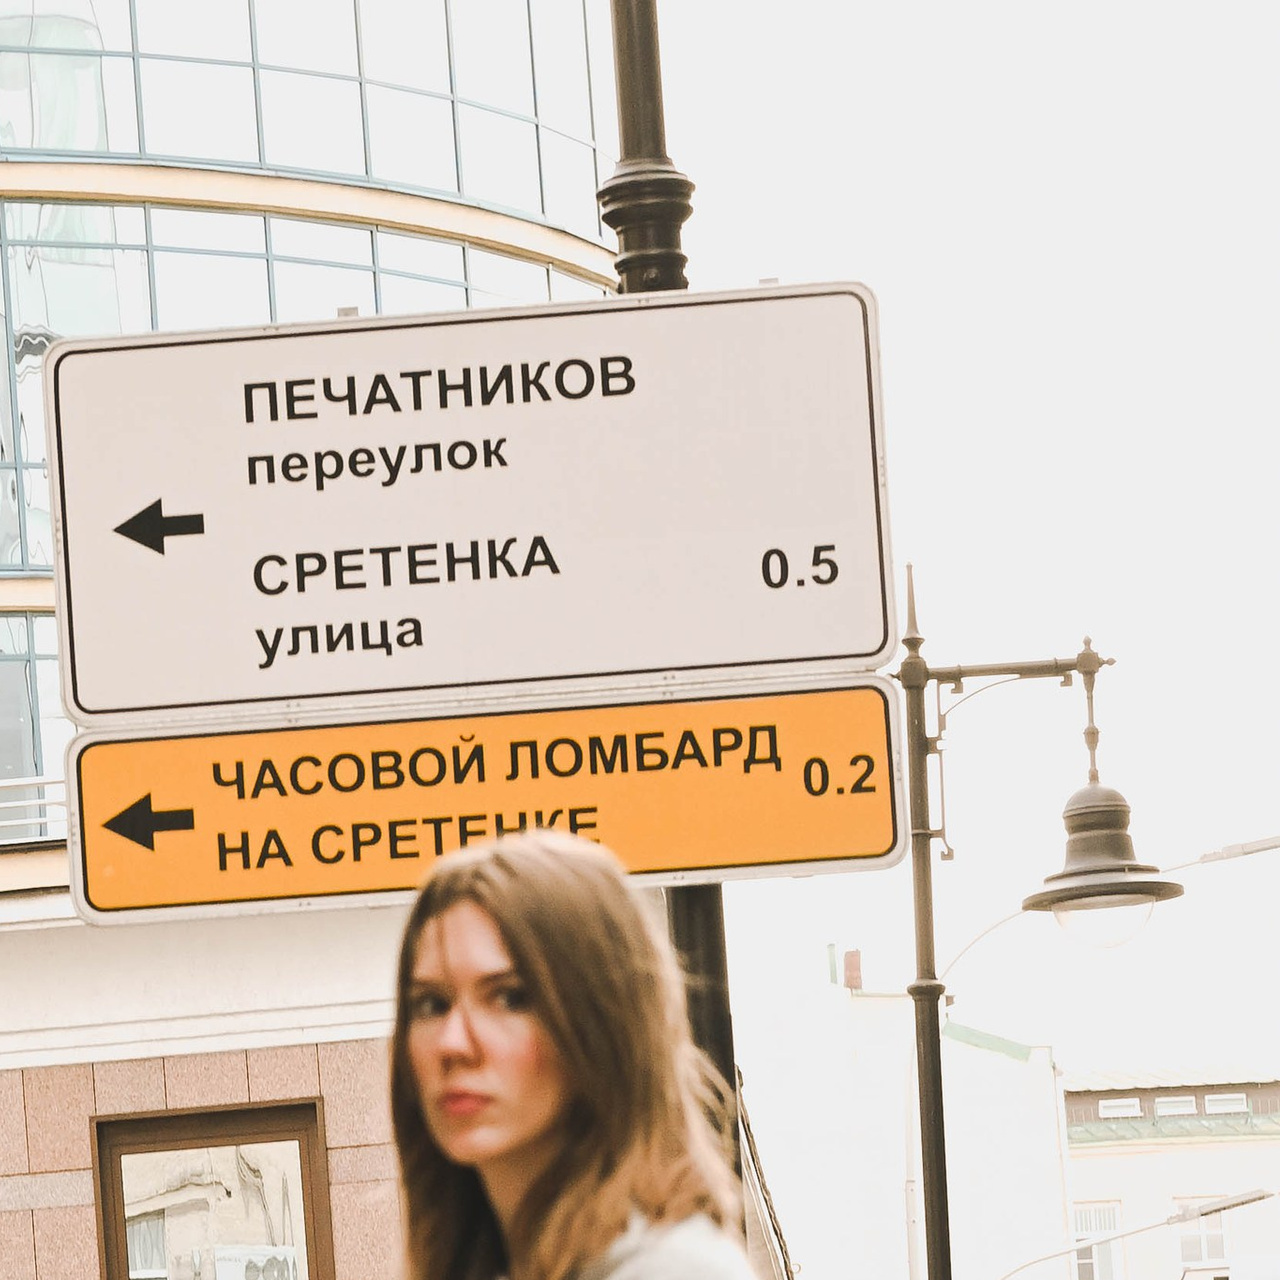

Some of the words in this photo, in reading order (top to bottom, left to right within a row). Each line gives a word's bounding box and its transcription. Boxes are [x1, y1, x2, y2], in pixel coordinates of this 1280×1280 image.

[244, 356, 636, 424] ПЕЧАТНИКОВ
[247, 438, 509, 491] переулок
[253, 536, 561, 597] СРЕТЕНКА
[761, 544, 840, 589] 0.5
[256, 617, 424, 669] улица
[212, 734, 486, 801] ЧАСОВОЙ
[505, 724, 782, 782] ЛОМБАРД
[803, 754, 877, 798] 0.2
[217, 829, 294, 873] НА
